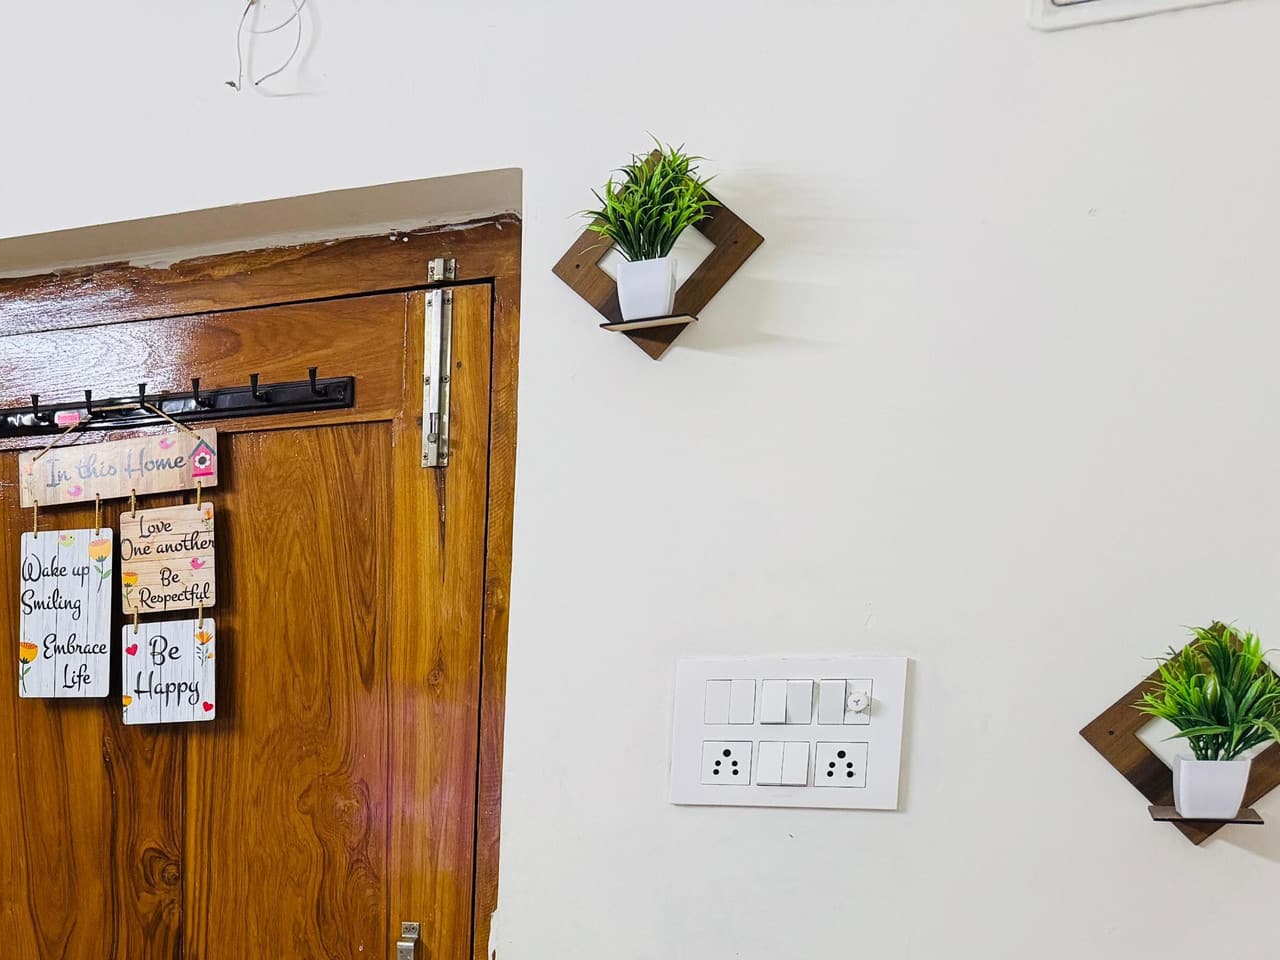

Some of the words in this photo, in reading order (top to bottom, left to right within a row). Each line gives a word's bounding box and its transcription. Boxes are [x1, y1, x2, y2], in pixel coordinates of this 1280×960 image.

[47, 456, 71, 488] In
[77, 456, 117, 479] this
[124, 450, 187, 477] Home
[139, 515, 173, 539] Love
[120, 538, 152, 561] One
[156, 531, 216, 555] another
[21, 553, 68, 582] Wake
[71, 565, 90, 587] up
[160, 567, 181, 587] Be
[21, 589, 81, 620] Smiling
[138, 582, 211, 609] Respectful
[43, 633, 107, 659] Embrace
[149, 635, 182, 666] Be
[62, 664, 92, 692] Life
[133, 671, 201, 706] Happy
